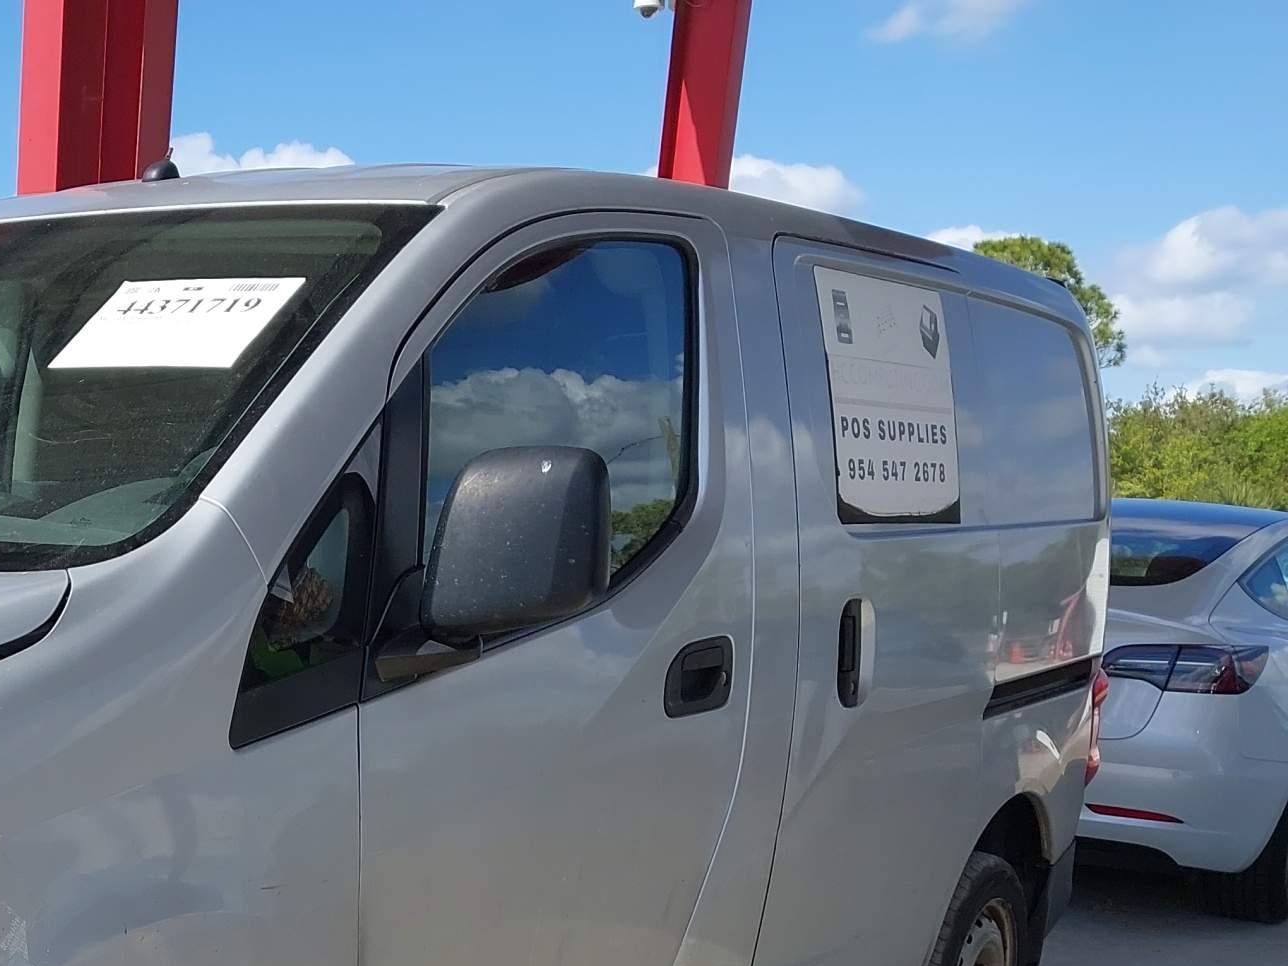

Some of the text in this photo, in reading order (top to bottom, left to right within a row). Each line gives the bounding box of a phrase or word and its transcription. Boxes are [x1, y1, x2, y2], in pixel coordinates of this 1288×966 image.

[117, 298, 262, 315] 44371719
[841, 416, 947, 445] POS SUPPLIES
[848, 458, 946, 482] 954 547 2678
